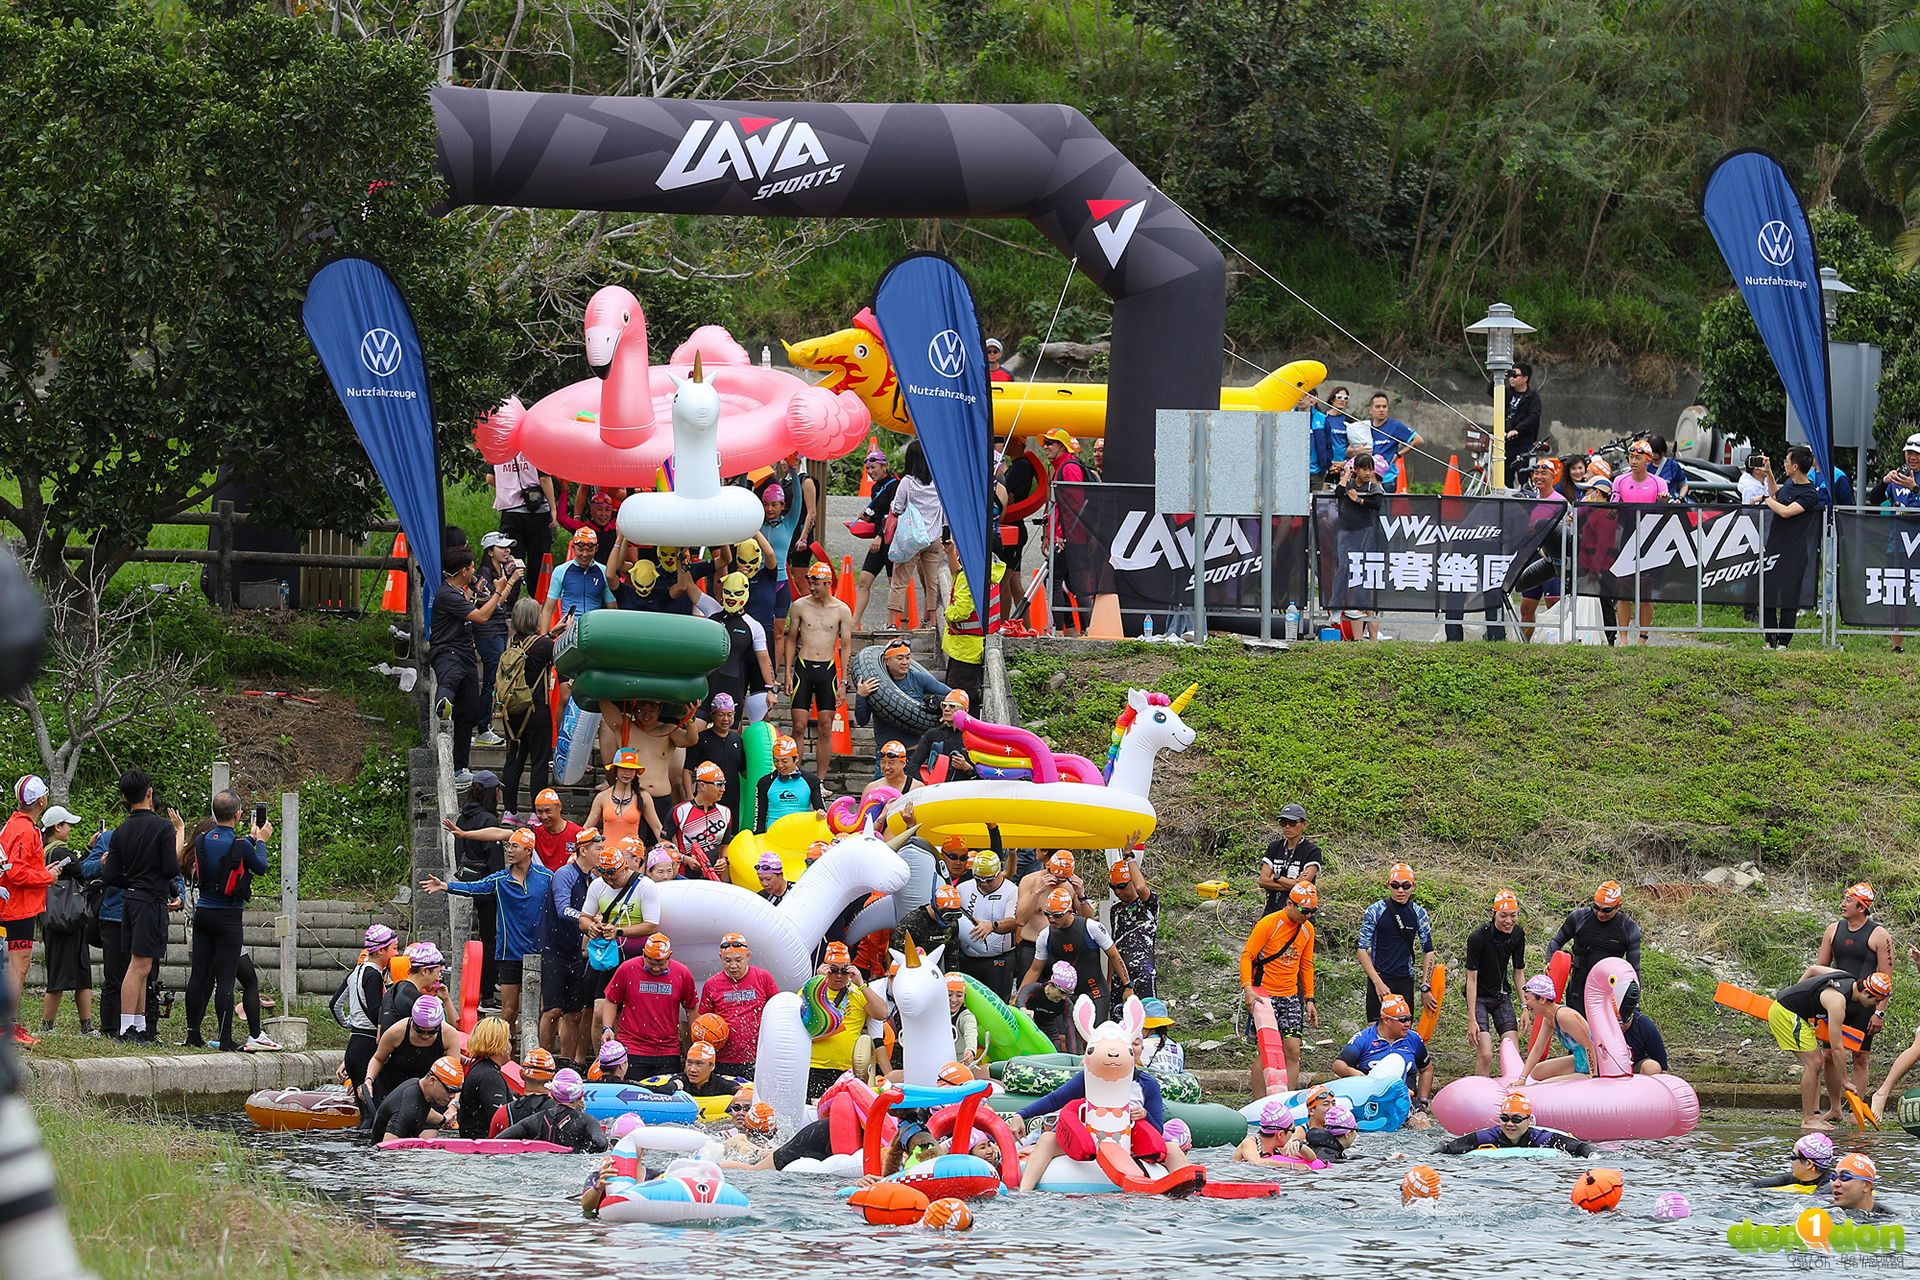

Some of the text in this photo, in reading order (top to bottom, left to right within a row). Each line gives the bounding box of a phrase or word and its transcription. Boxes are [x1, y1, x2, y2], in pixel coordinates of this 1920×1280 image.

[655, 117, 830, 191] LAVA
[751, 164, 846, 201] SPORTS
[1744, 276, 1808, 290] Nutzfahrzeuge
[346, 386, 417, 400] Nutzfahrzeuge
[908, 383, 977, 405] Nutzfahrzeuge
[1609, 509, 1767, 578] LAVA
[1701, 553, 1781, 589] SPORTS
[1865, 567, 1920, 606] 玩
